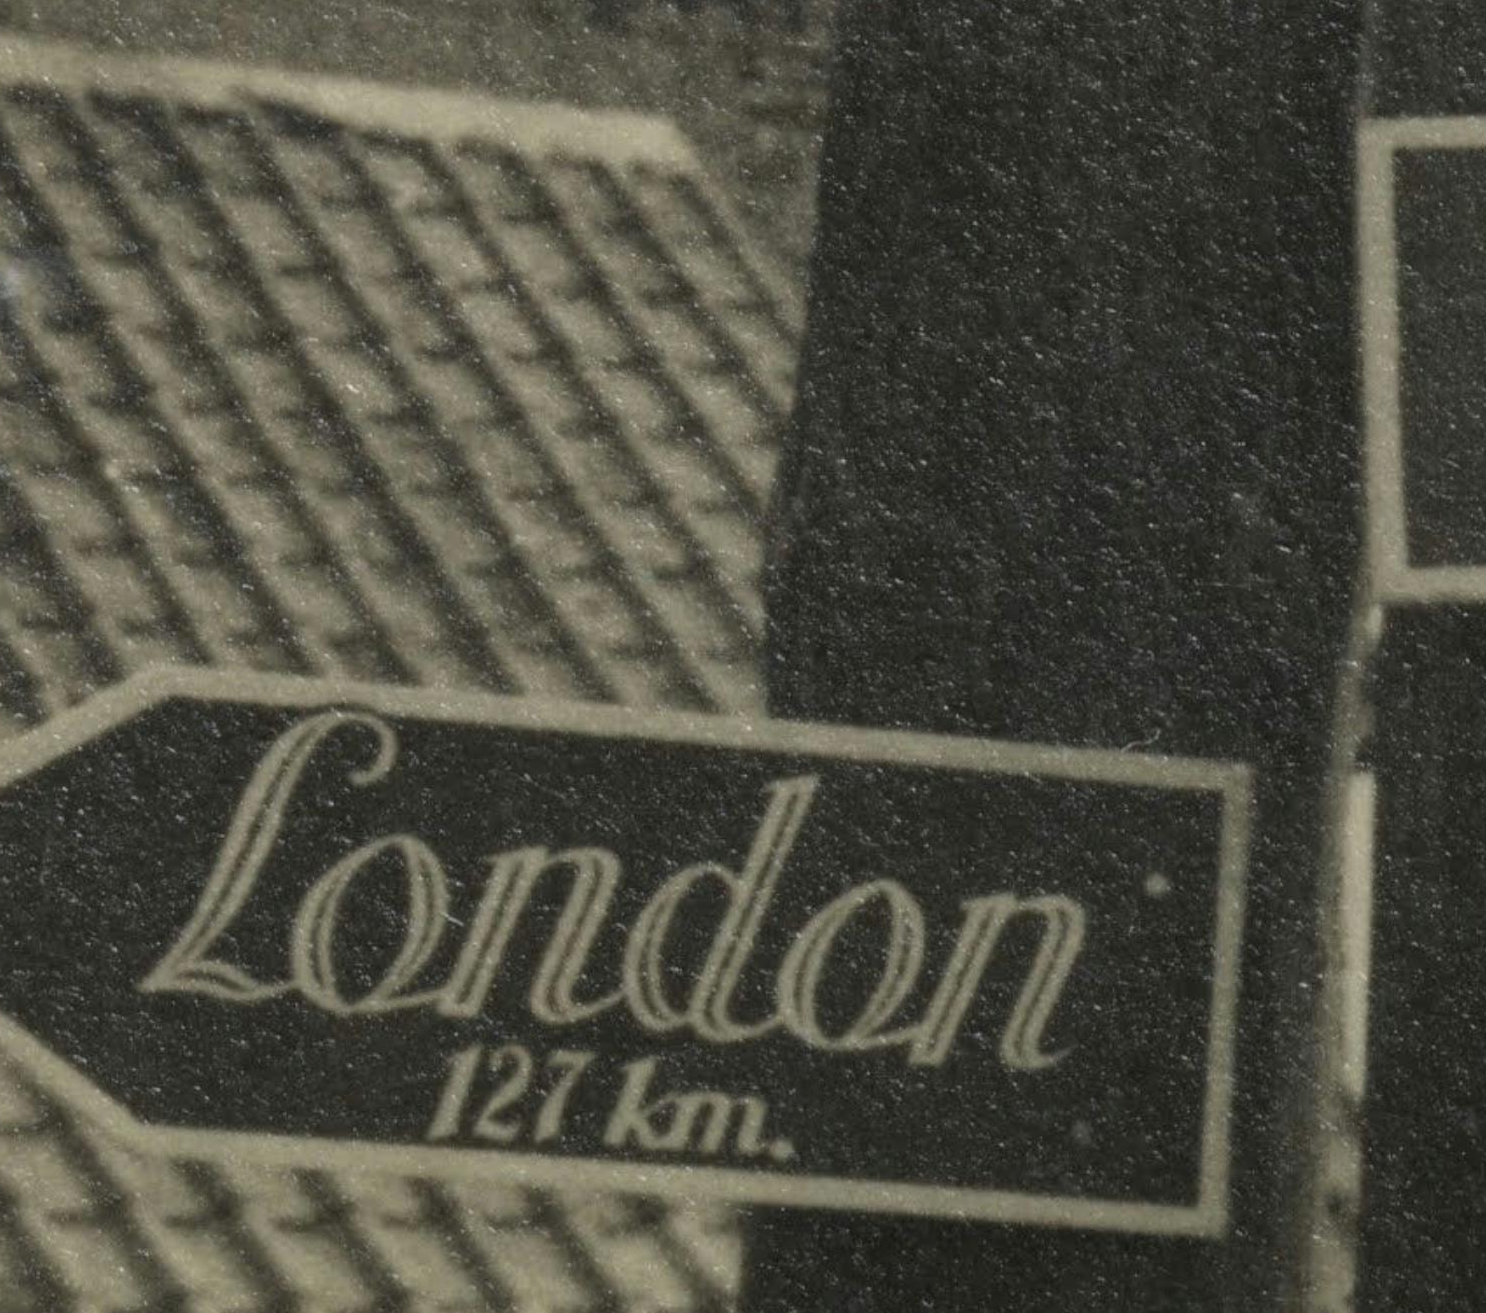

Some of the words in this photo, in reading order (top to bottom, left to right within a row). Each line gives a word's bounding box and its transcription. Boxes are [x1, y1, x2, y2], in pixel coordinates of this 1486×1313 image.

[136, 709, 1087, 1072] London
[425, 1043, 595, 1143] 127
[603, 1055, 795, 1162] km.
